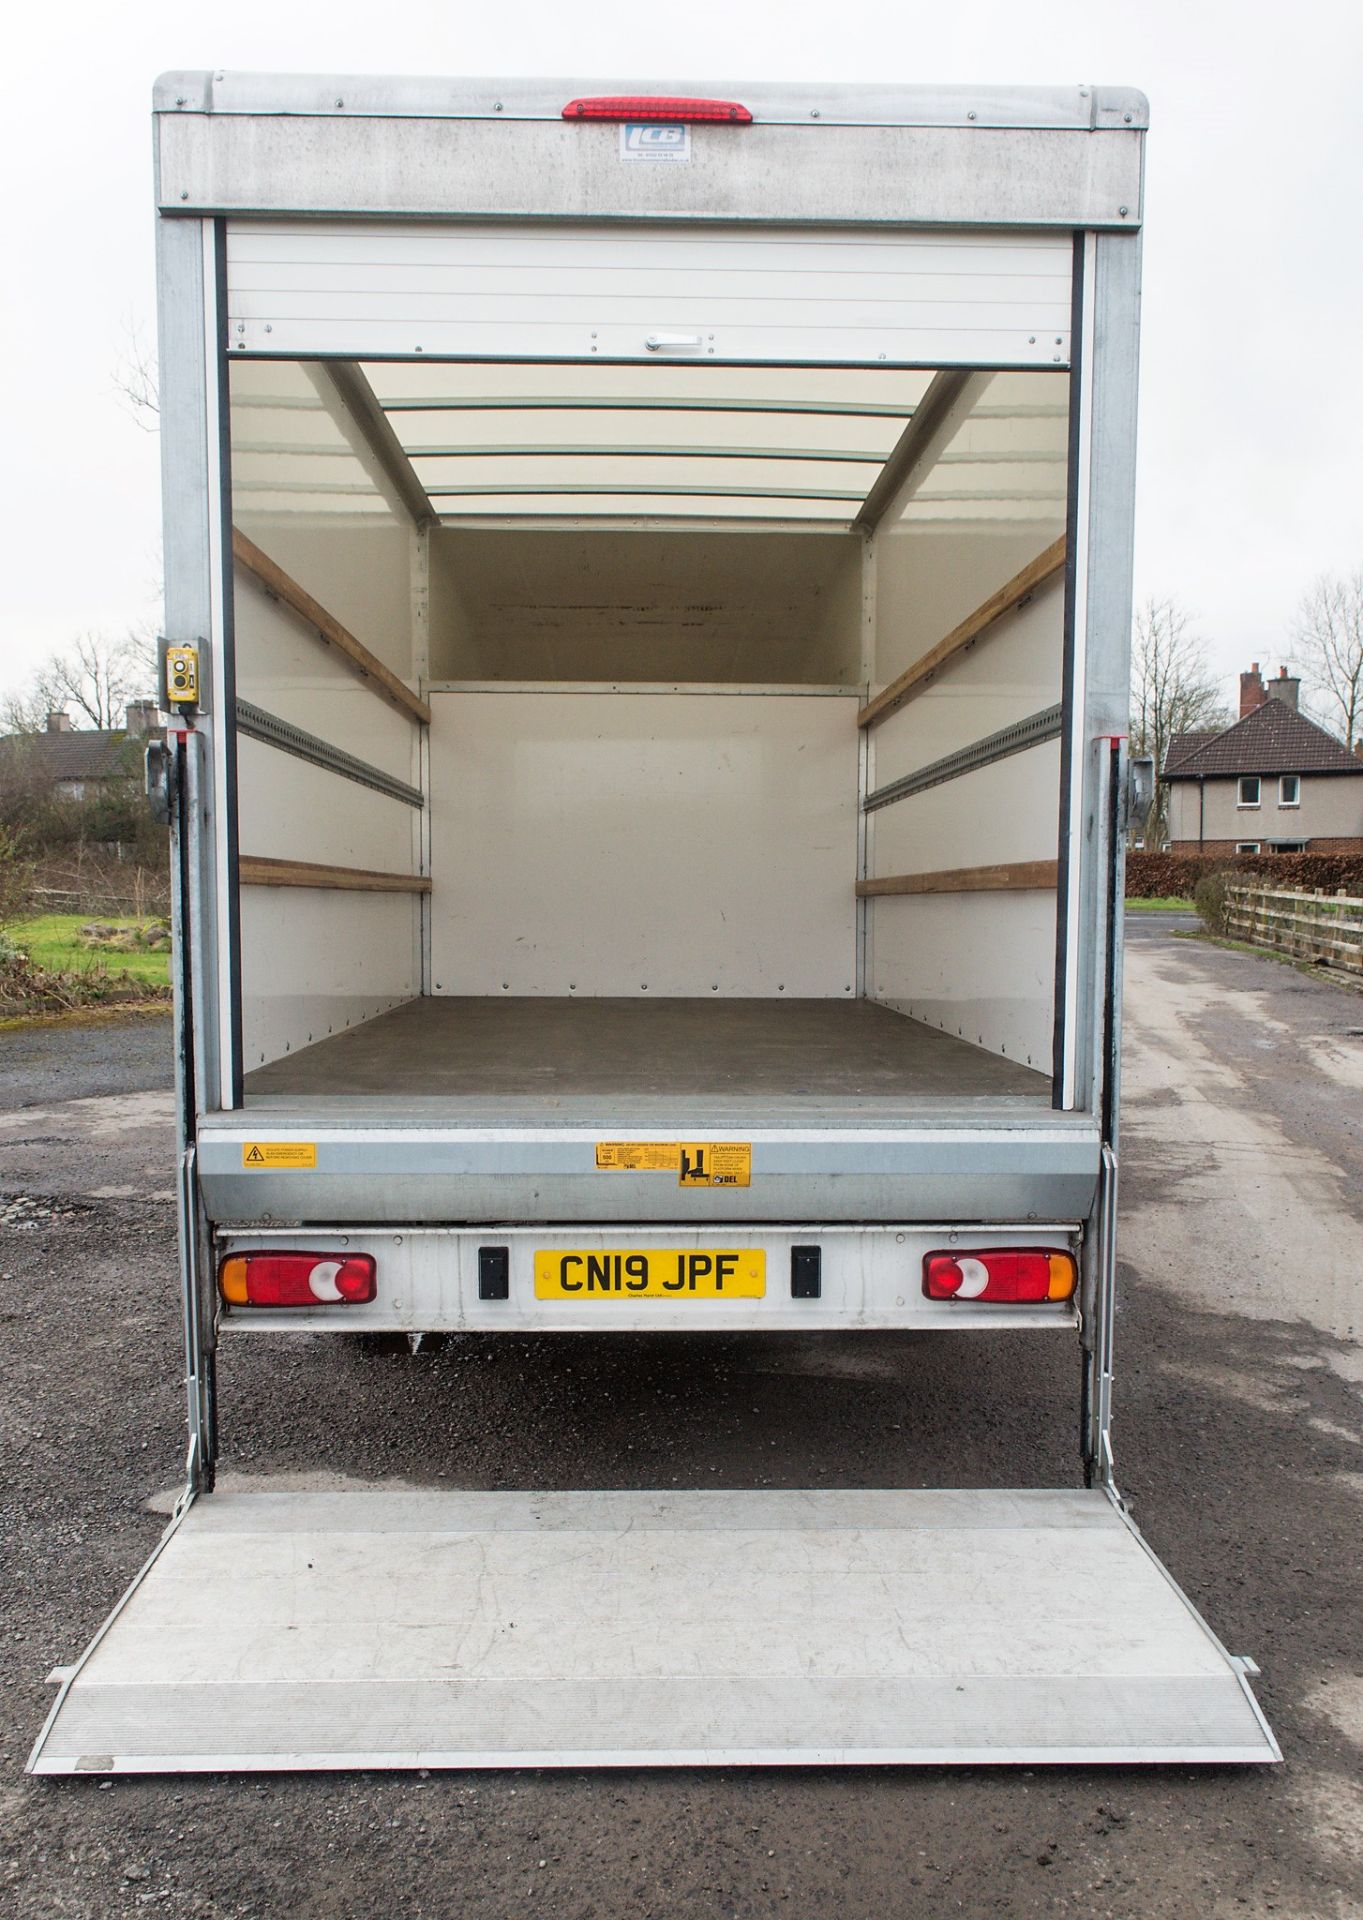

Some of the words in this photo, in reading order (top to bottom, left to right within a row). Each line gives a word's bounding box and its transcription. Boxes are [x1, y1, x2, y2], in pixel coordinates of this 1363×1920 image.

[724, 1175, 737, 1183] DEL
[560, 1255, 649, 1291] CN19
[662, 1254, 740, 1290] JPF
